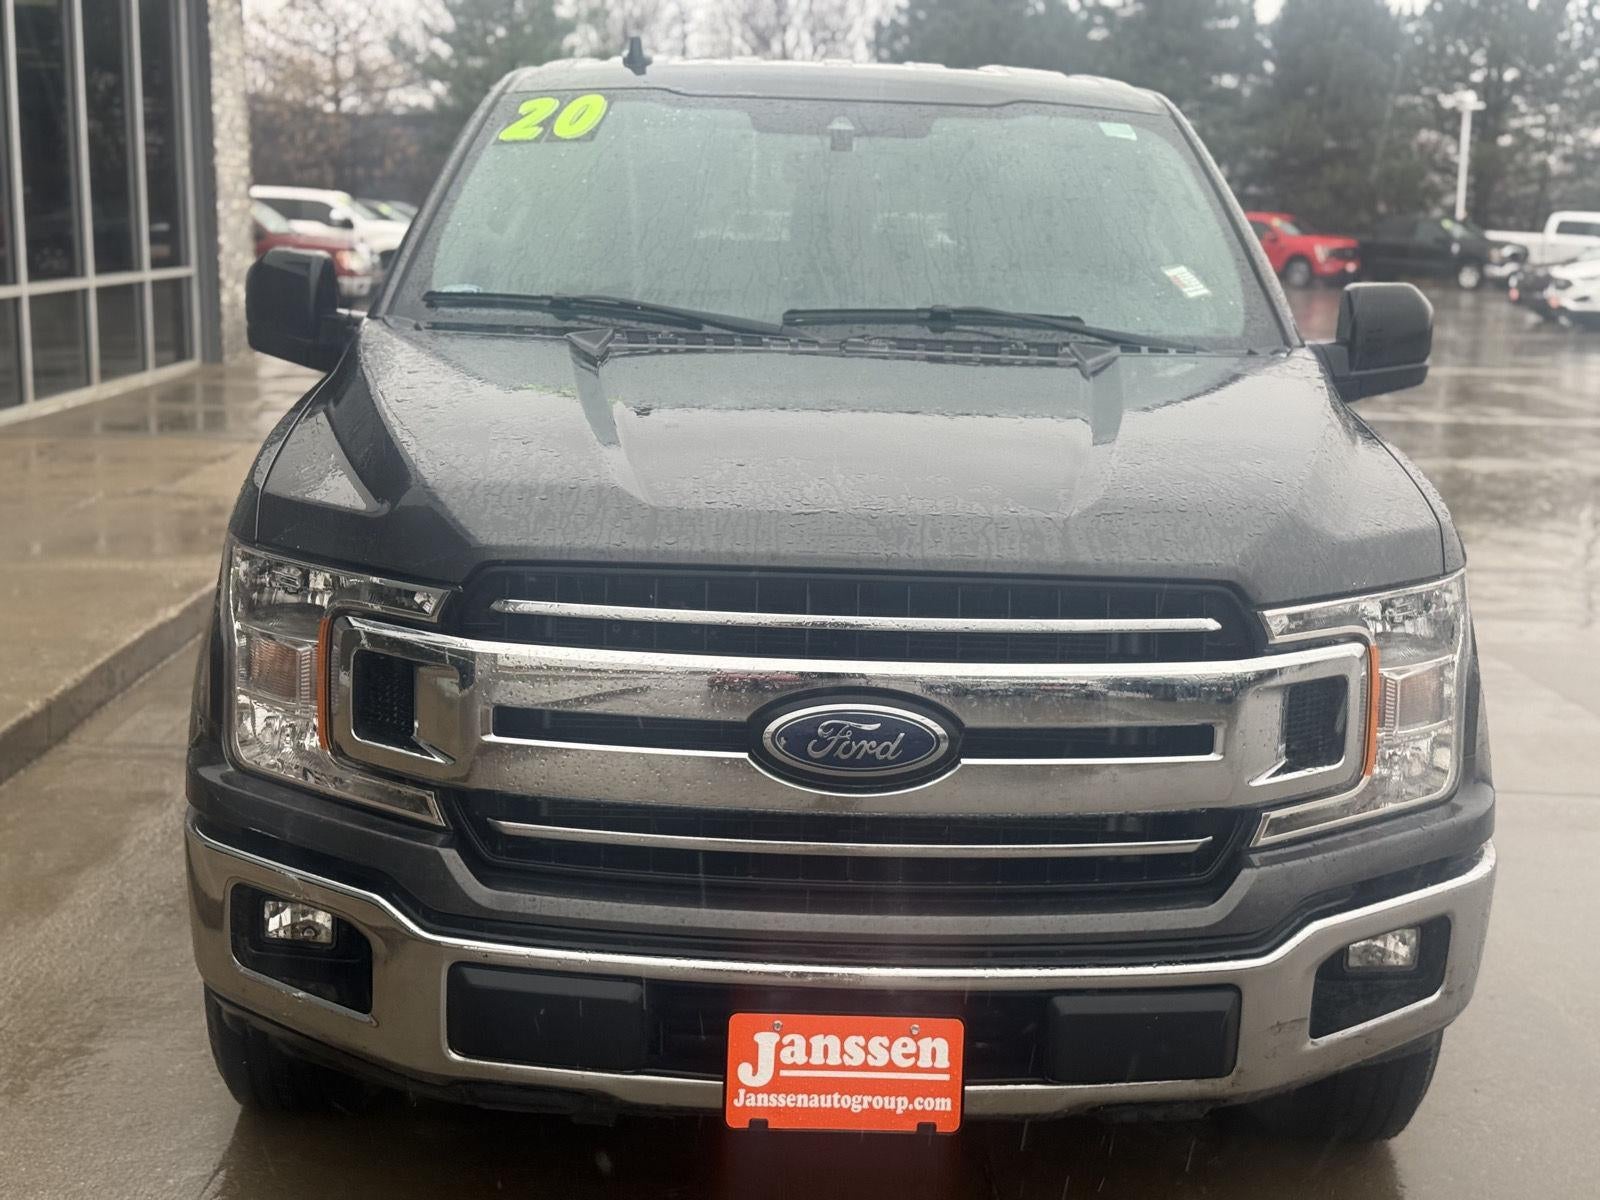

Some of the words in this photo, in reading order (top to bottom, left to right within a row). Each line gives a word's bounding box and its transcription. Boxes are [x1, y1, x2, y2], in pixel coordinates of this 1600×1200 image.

[498, 94, 608, 141] 20
[807, 719, 905, 760] Ford
[737, 1031, 950, 1087] Janssen
[733, 1088, 952, 1114] Janssenautogroup.com
